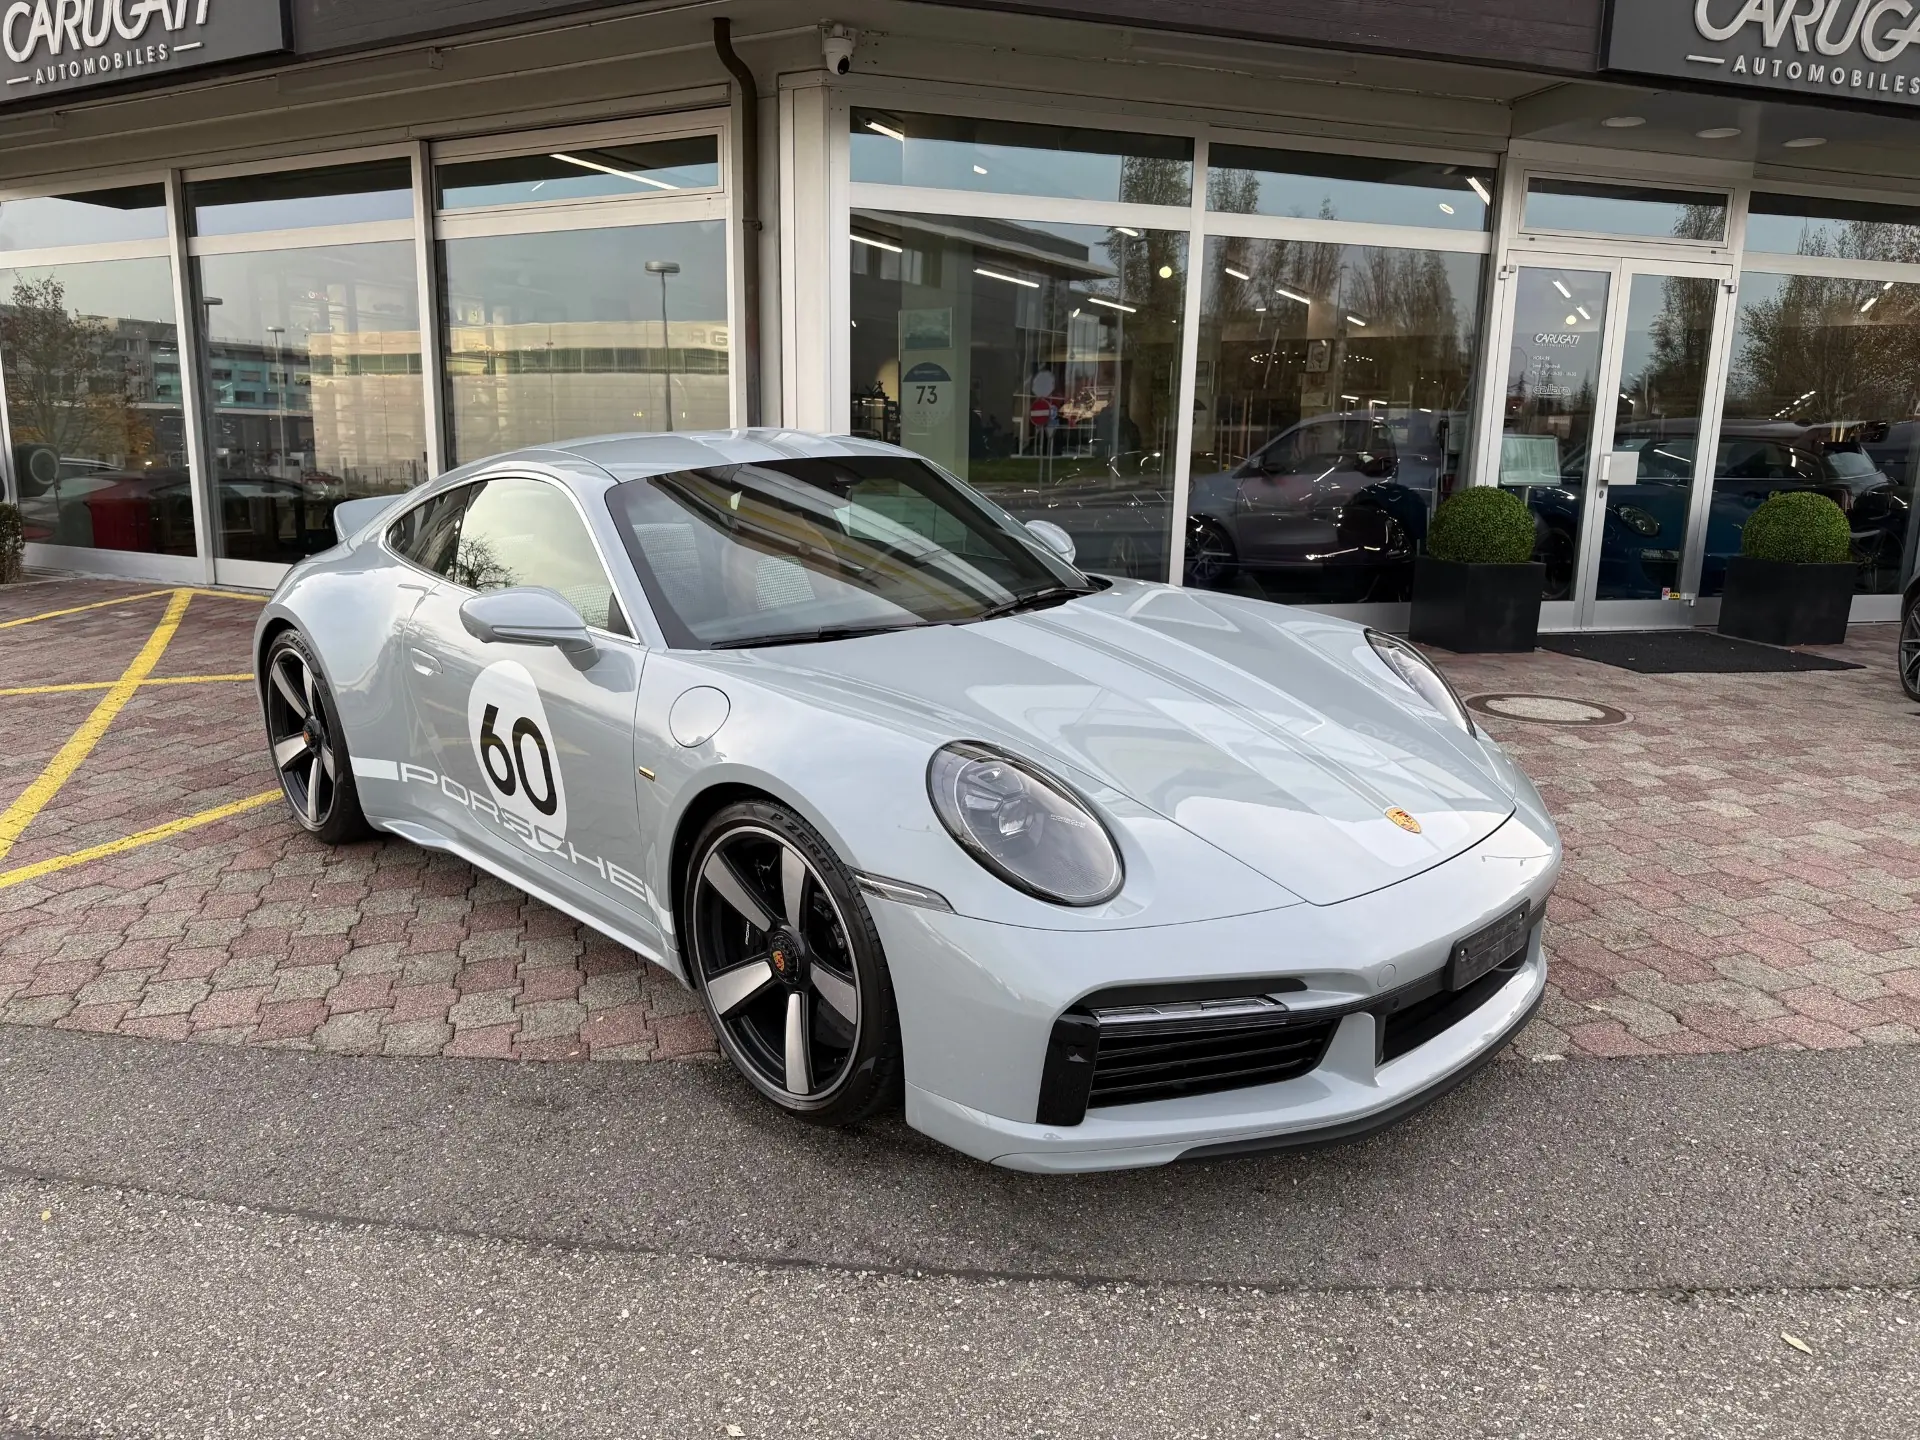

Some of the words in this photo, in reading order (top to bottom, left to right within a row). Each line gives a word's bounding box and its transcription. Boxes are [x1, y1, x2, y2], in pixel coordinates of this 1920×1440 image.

[35, 44, 168, 85] AUTOMOBILES
[1732, 55, 1920, 95] AUTOMOBILES
[1535, 333, 1580, 345] CARUGATI
[915, 385, 938, 405] 73
[480, 703, 557, 816] 60
[401, 762, 648, 902] PORSCHE
[770, 813, 784, 821] P
[784, 821, 835, 872] ZERO
